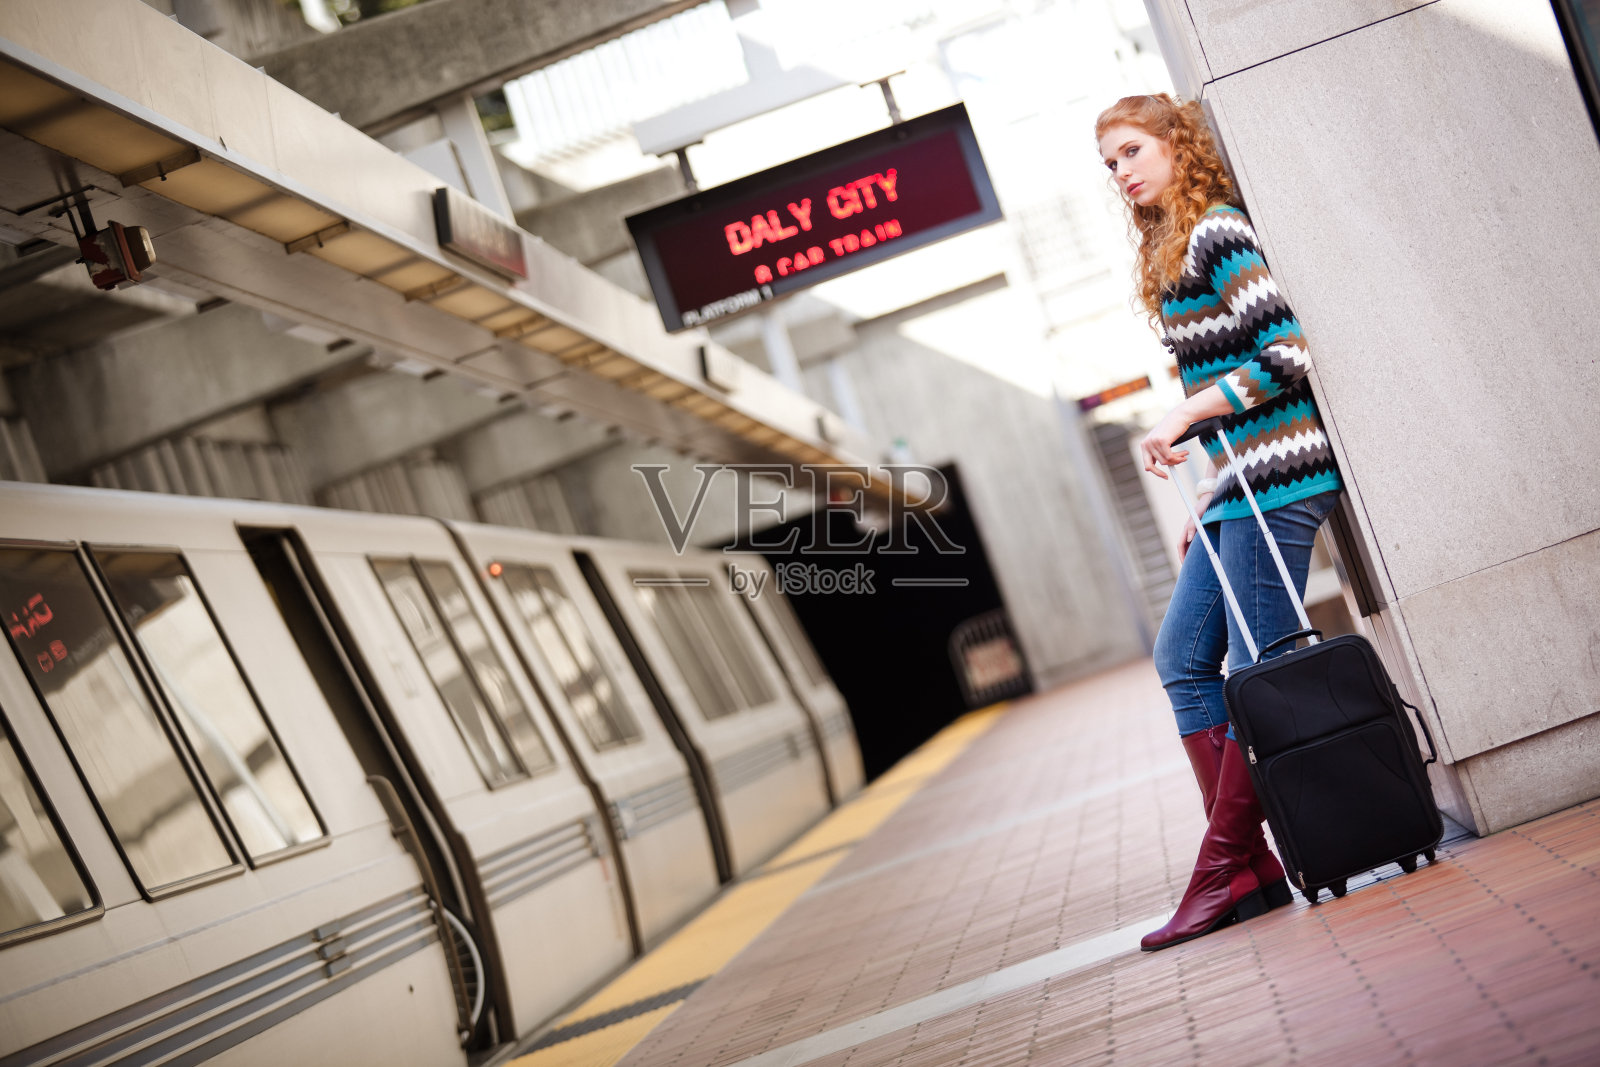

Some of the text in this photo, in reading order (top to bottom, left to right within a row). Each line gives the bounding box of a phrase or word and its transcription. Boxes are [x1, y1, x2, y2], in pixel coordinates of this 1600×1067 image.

[725, 168, 898, 255] DALY CITY
[829, 218, 902, 256] TRAIN
[682, 287, 761, 329] PLATFORM
